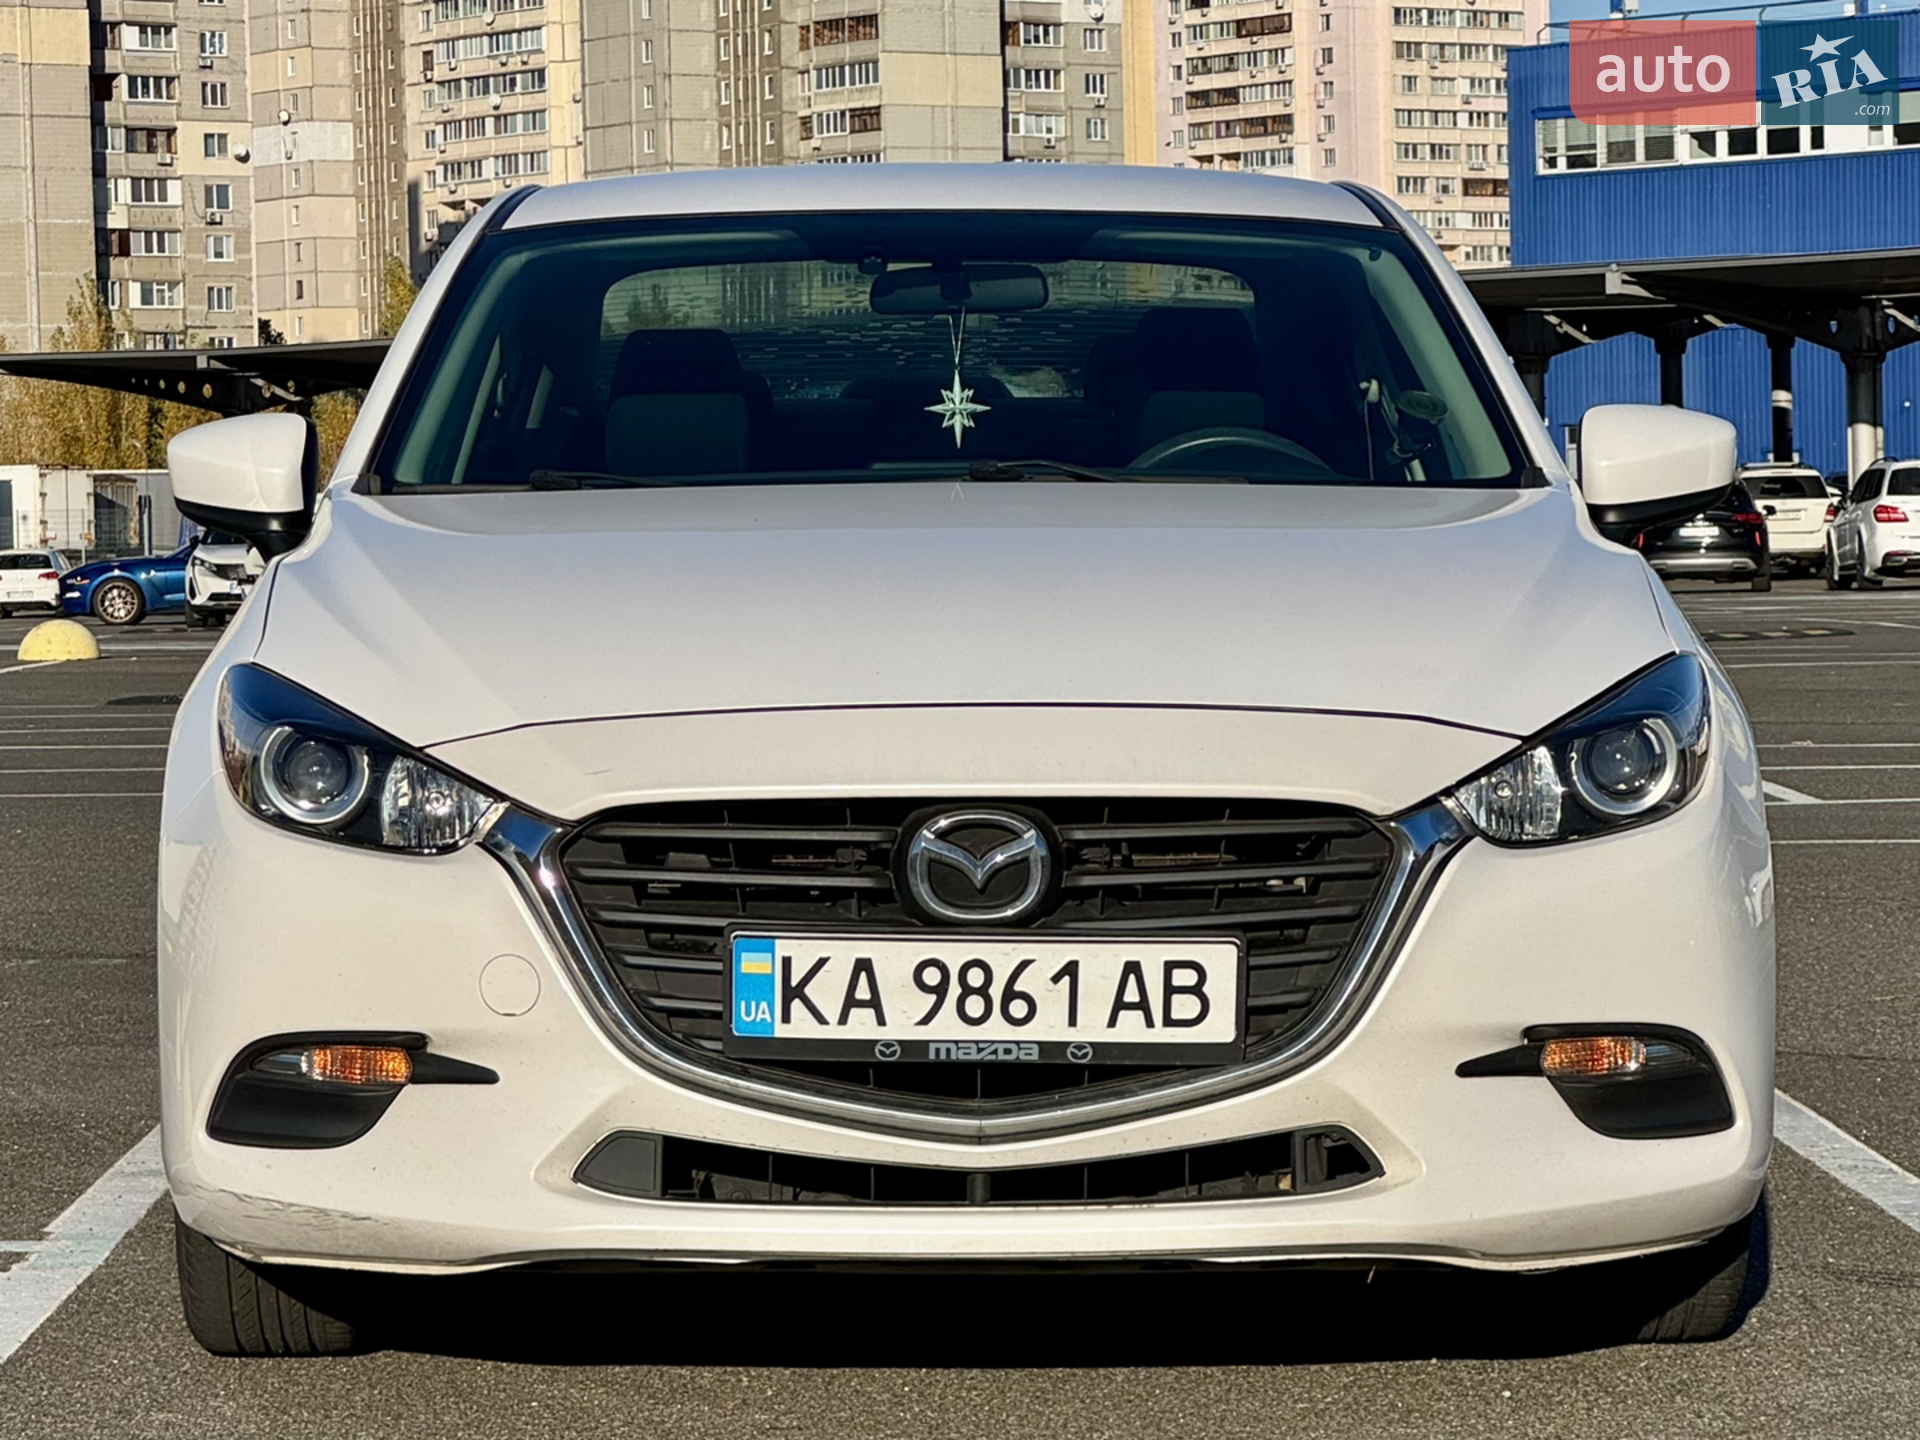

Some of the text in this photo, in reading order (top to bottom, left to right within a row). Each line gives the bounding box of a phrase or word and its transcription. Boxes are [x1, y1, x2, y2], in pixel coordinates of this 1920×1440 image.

[740, 1000, 772, 1023] UA
[781, 955, 1211, 1029] KA 9861 AB
